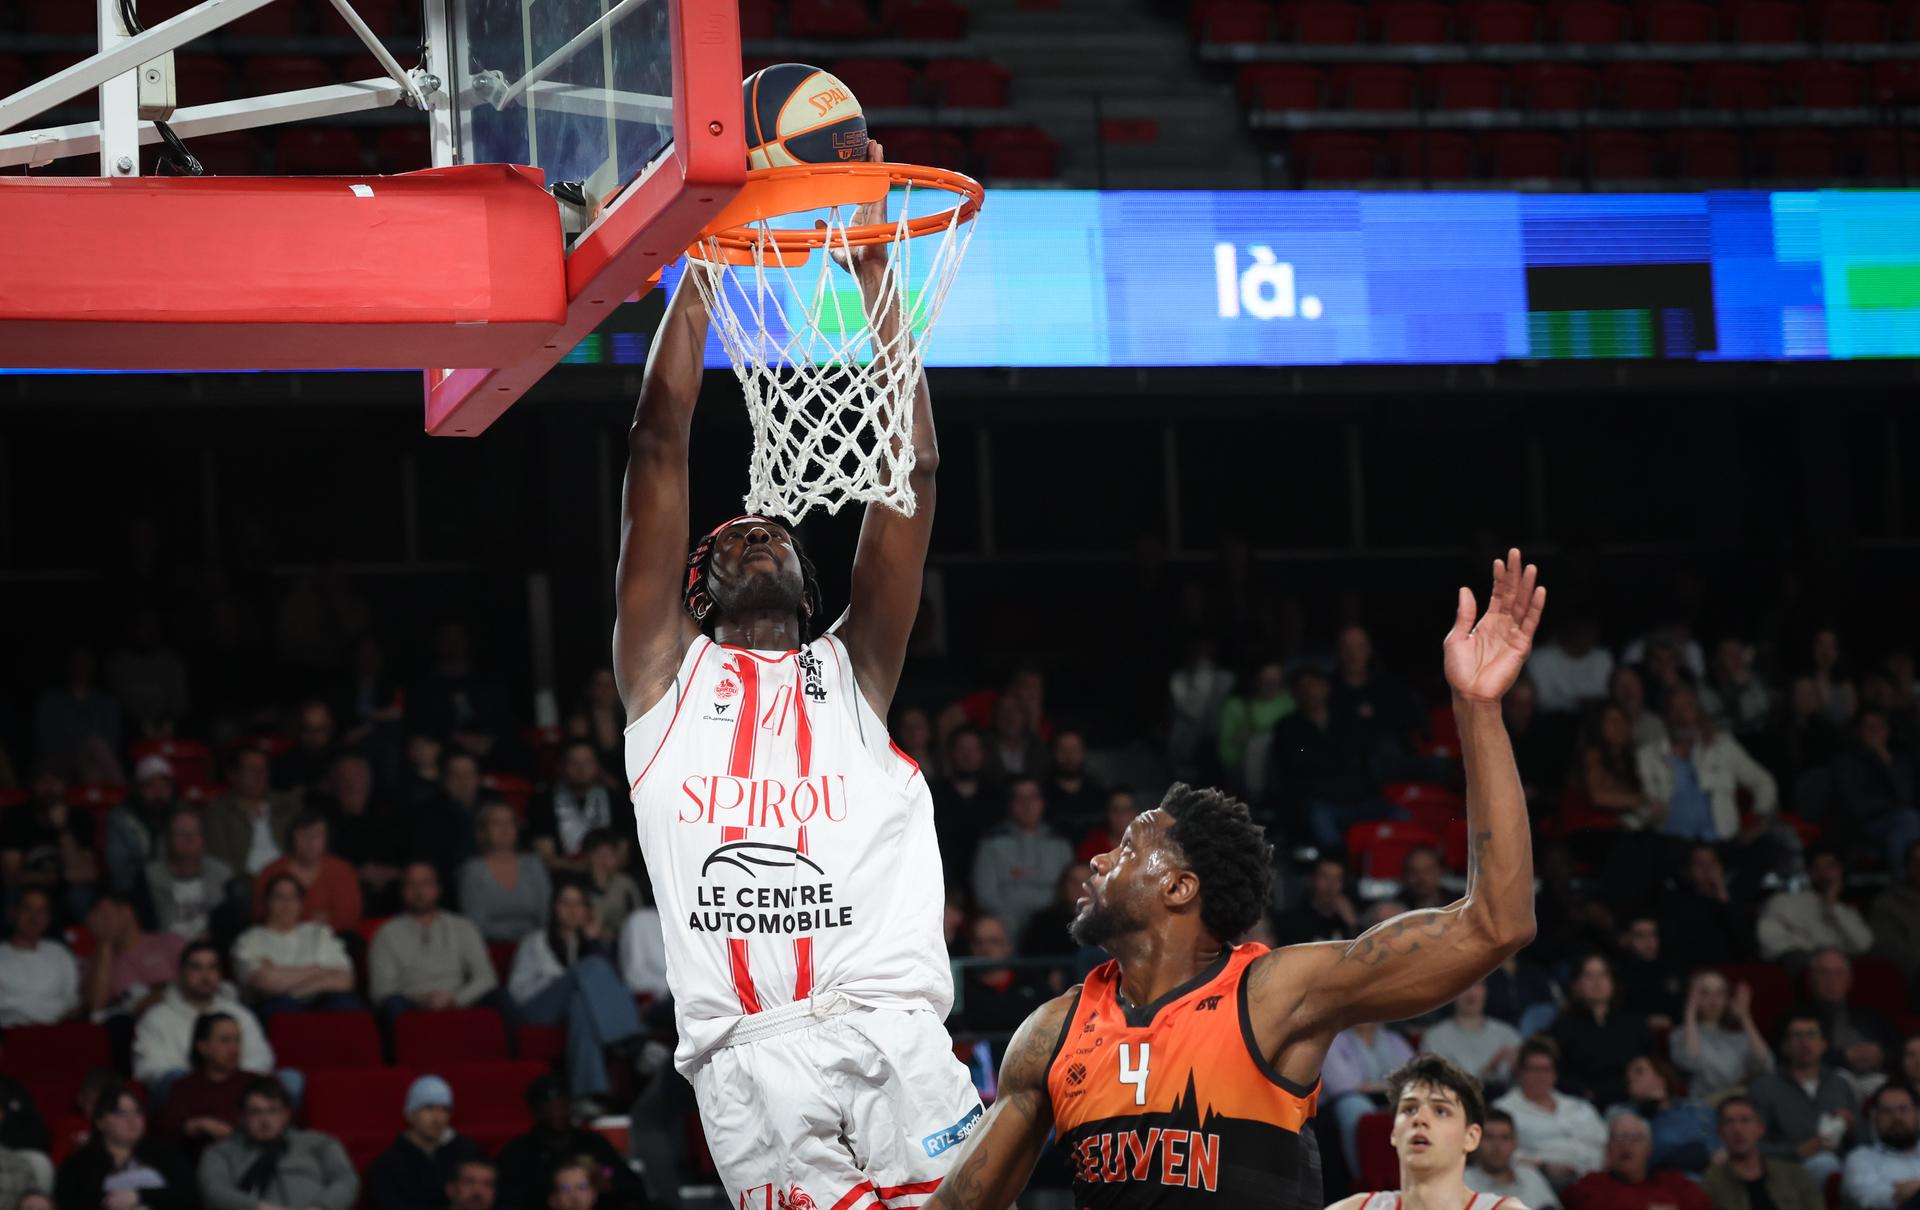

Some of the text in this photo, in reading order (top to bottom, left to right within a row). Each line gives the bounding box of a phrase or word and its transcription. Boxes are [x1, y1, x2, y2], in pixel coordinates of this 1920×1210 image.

[1214, 242, 1323, 320] là.
[679, 774, 847, 828] SPIROU
[698, 883, 833, 908] LE CENTRE
[689, 906, 852, 934] AUTOMOBILE
[1118, 1042, 1150, 1106] 4
[927, 1132, 955, 1153] RTL
